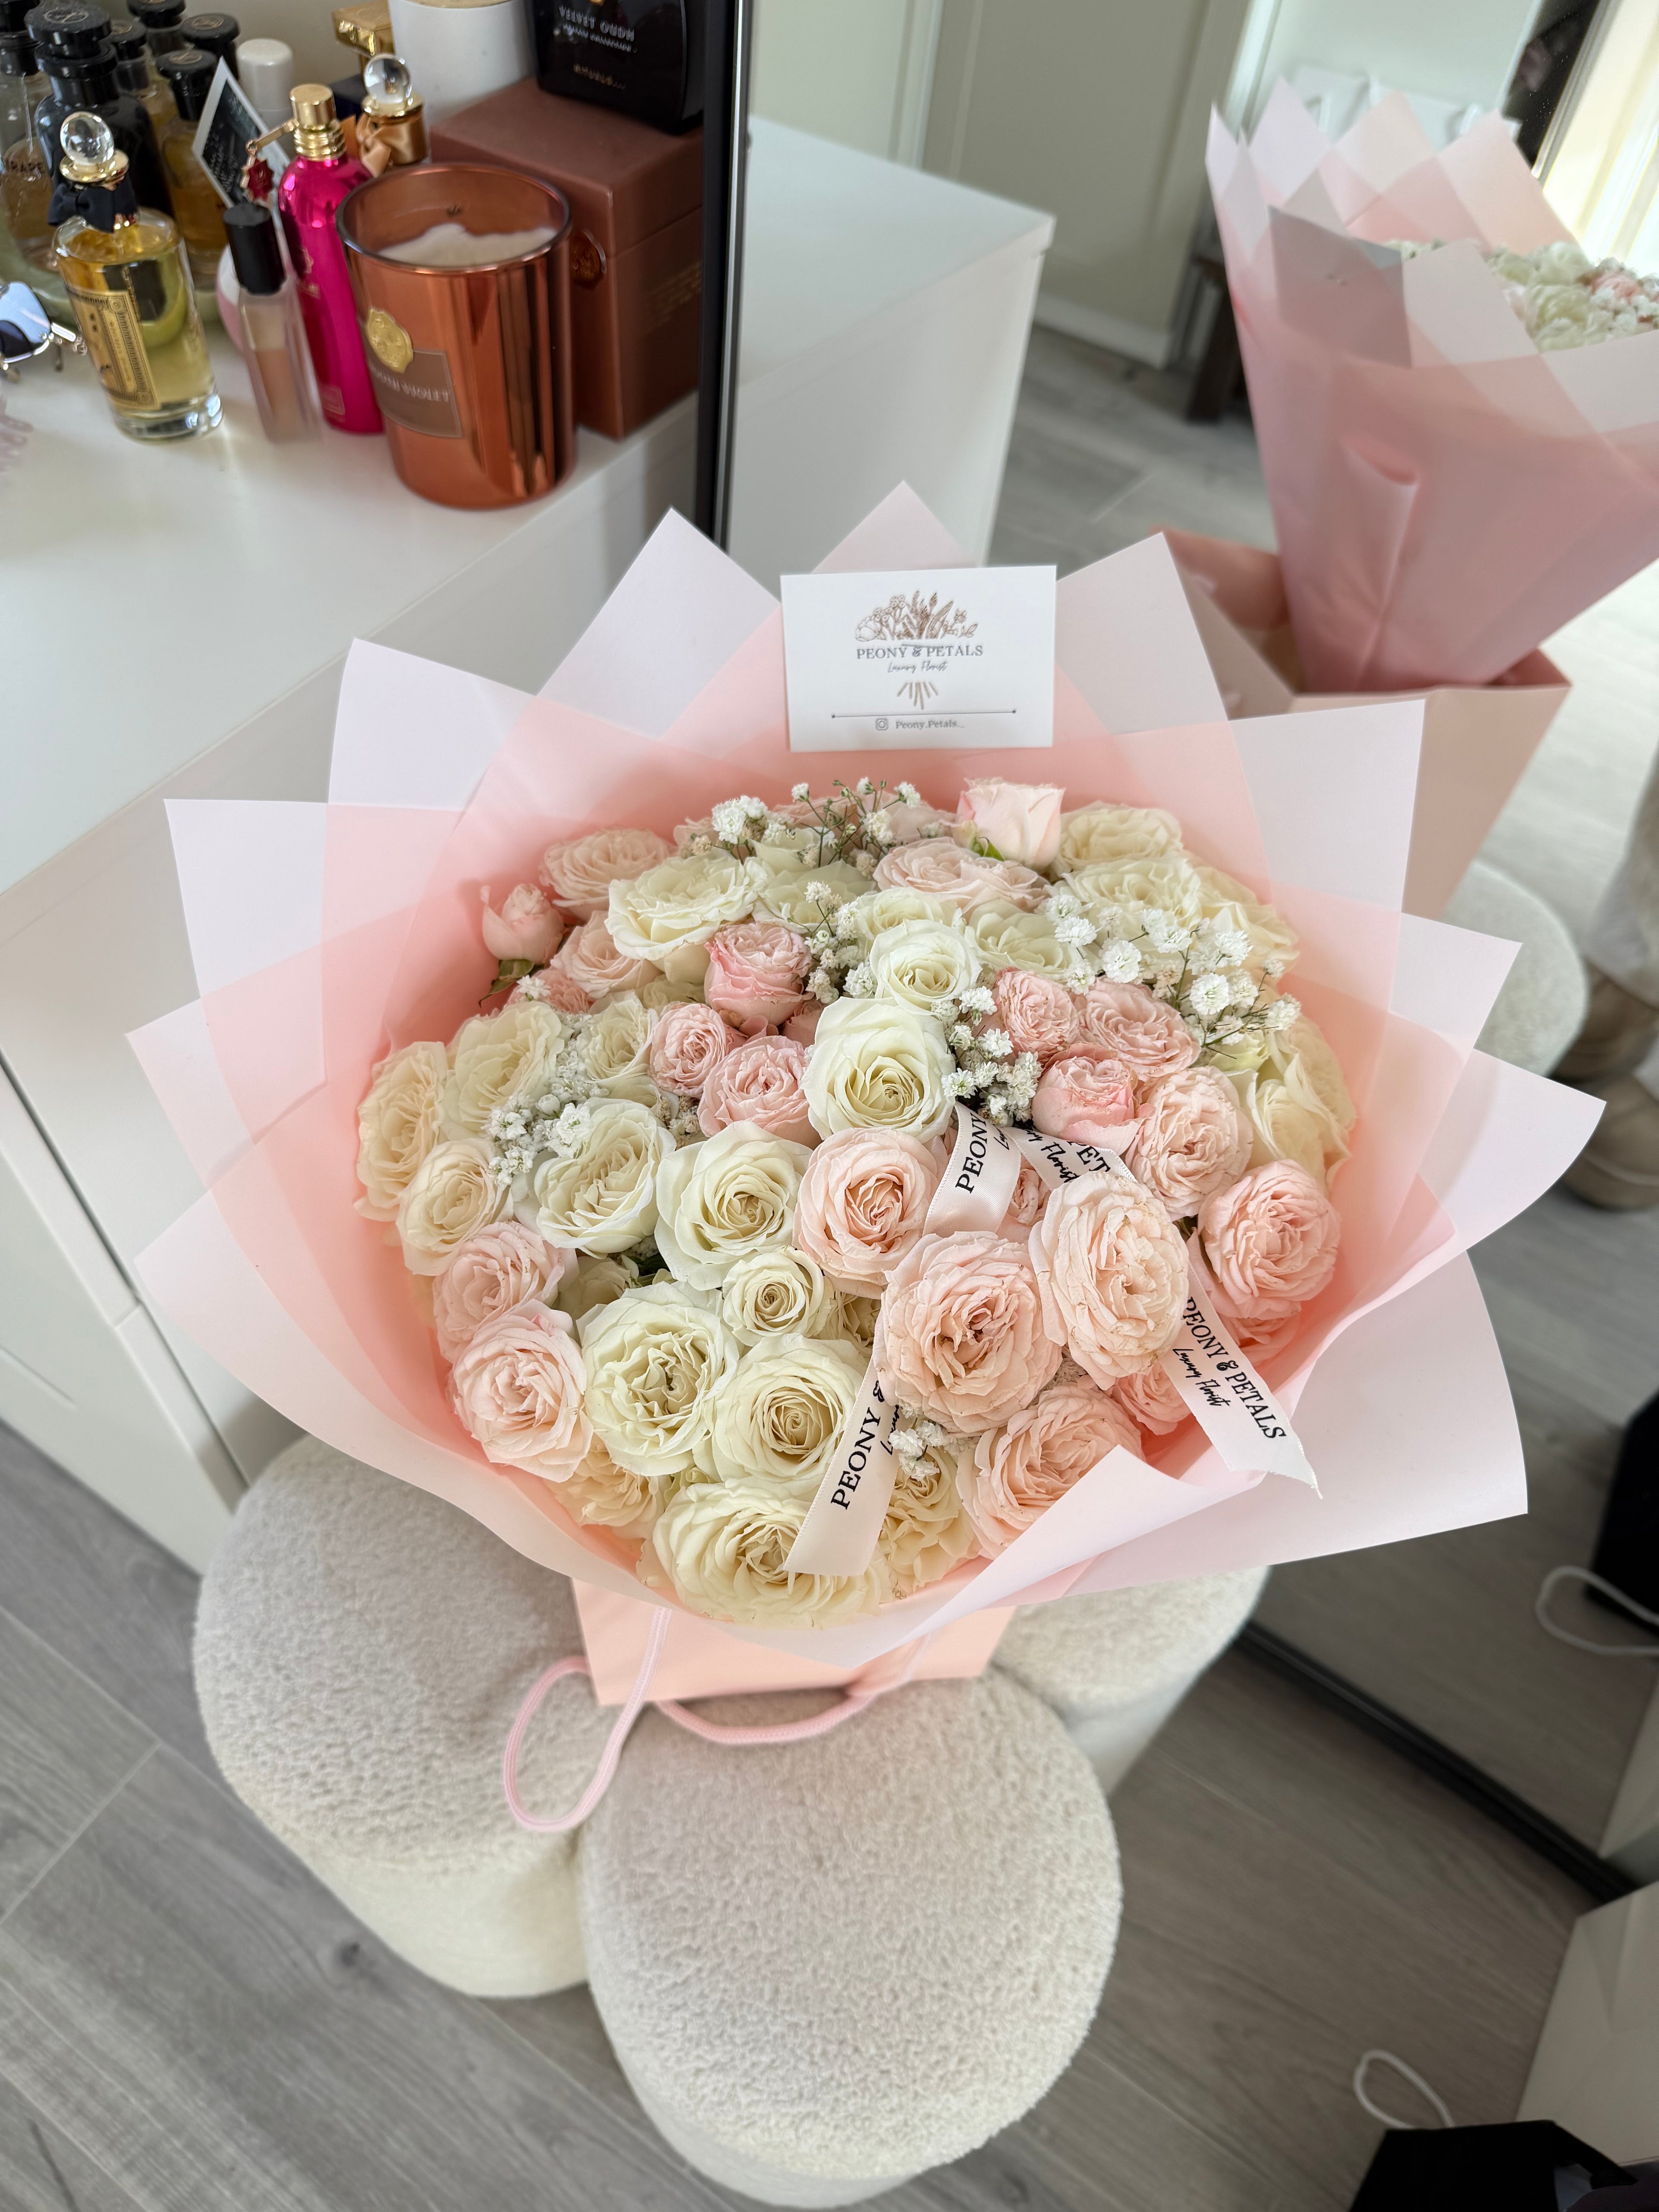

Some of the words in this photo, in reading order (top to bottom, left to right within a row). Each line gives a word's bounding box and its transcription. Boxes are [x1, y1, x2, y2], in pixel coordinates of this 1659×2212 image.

[559, 6, 596, 29] VELVET
[600, 20, 635, 42] OUDH
[857, 647, 907, 659] PEONY
[912, 646, 922, 657] &
[926, 645, 984, 657] PETALS
[888, 661, 917, 674] Luxury
[921, 660, 949, 672] Florist
[955, 1112, 987, 1194] PEONY
[1182, 1297, 1229, 1358] PEONY
[1172, 1348, 1202, 1378] Luxury
[1195, 1379, 1230, 1406] Florist
[1216, 1360, 1239, 1371] &
[1225, 1371, 1287, 1438] PETALS
[830, 1407, 881, 1510] PEONY
